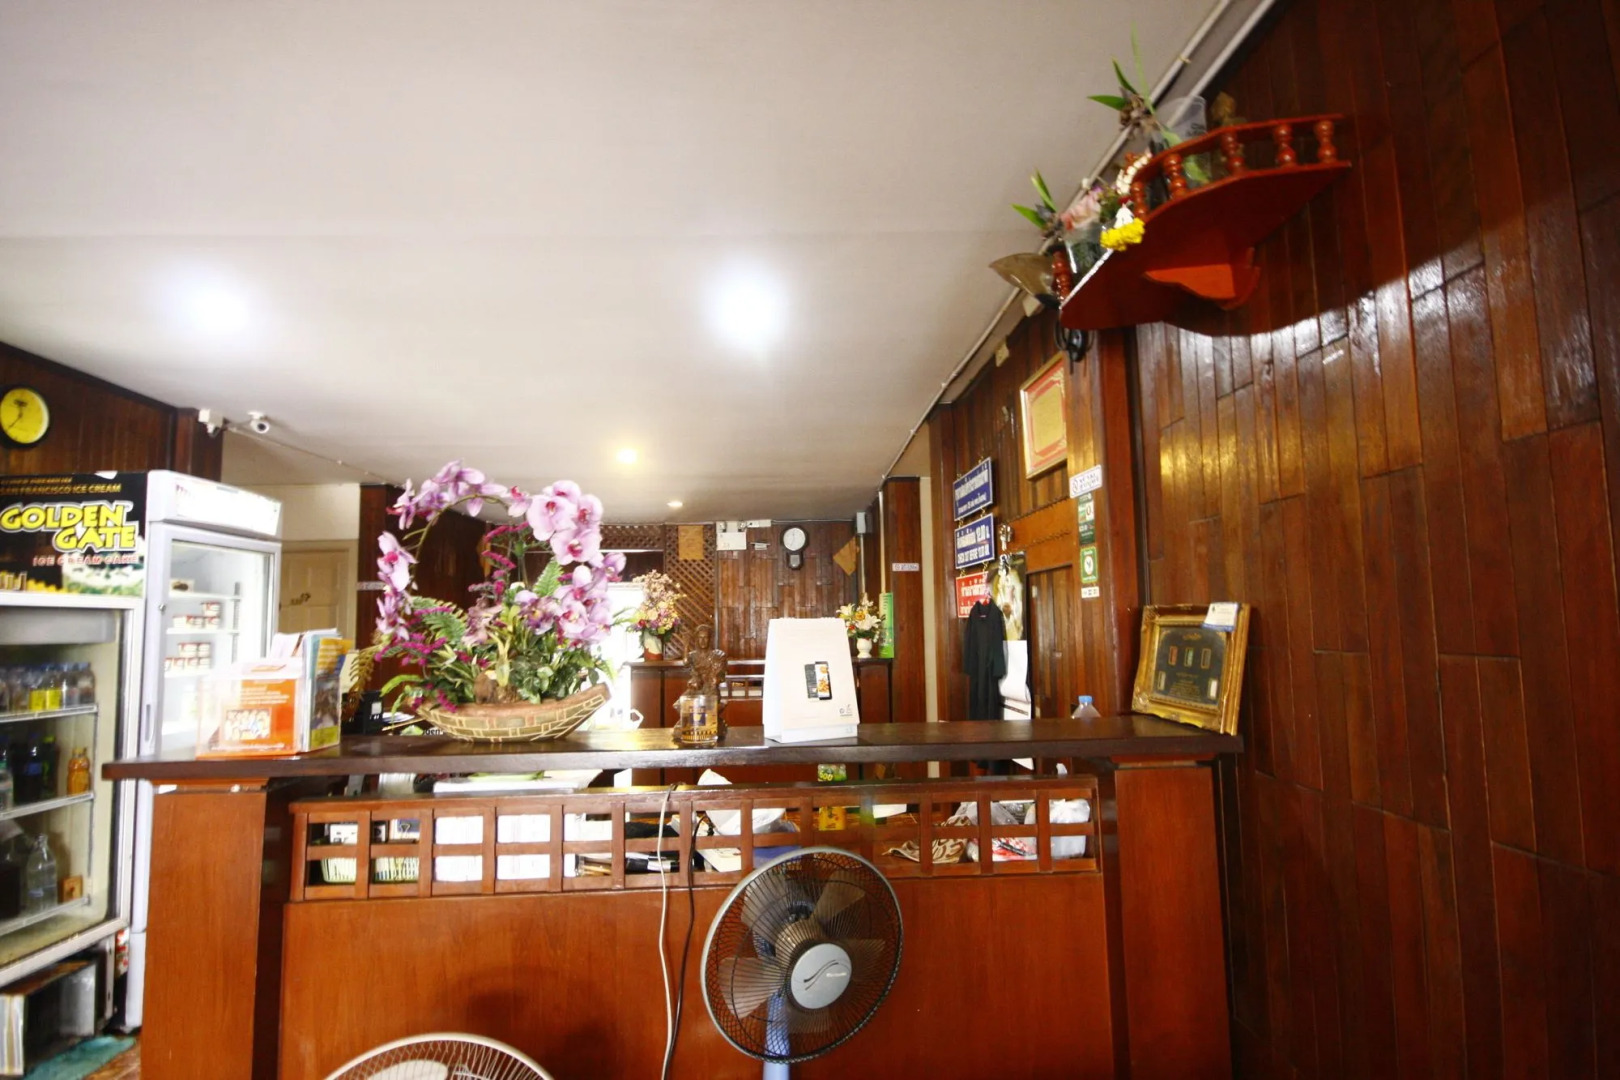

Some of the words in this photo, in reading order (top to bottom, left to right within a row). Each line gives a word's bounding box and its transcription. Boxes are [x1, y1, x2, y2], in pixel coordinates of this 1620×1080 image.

[72, 485, 87, 493] ICE
[88, 483, 121, 493] CREAM
[0, 504, 126, 530] GOLDEN
[54, 525, 136, 550] GATE
[32, 555, 55, 567] ICE
